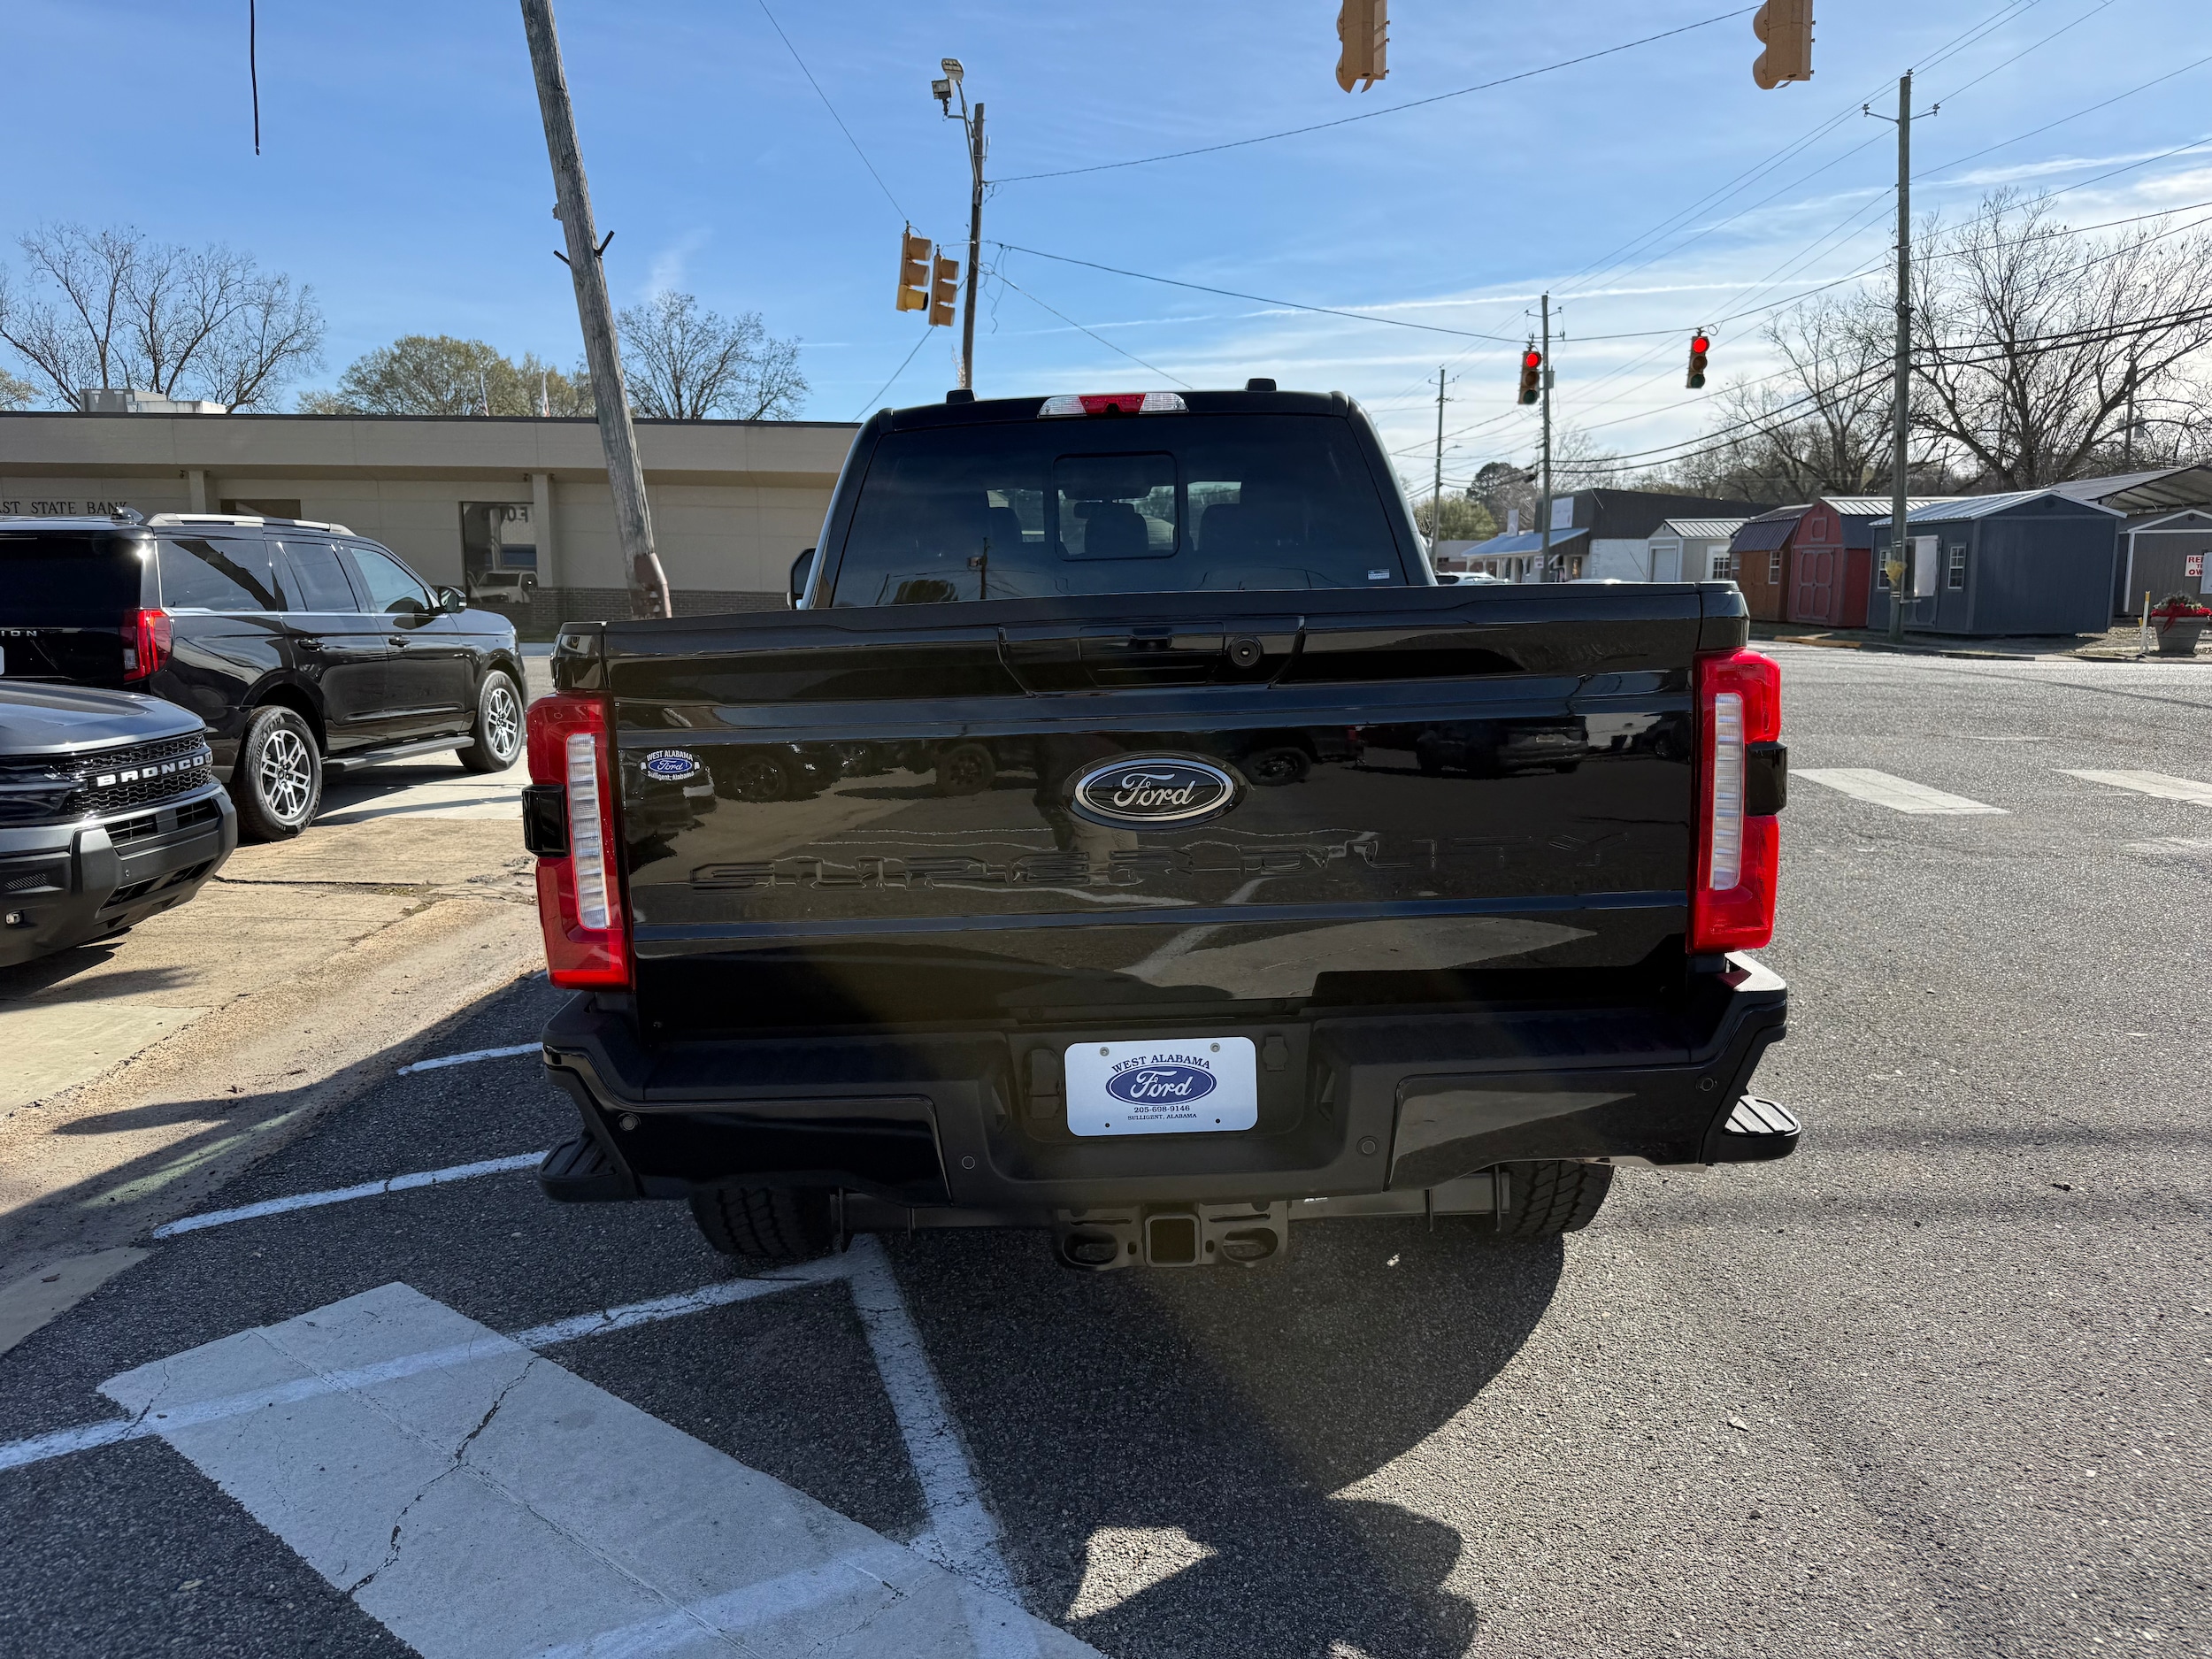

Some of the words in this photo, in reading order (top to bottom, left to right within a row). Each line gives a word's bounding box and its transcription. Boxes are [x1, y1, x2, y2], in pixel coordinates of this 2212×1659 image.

[0, 501, 20, 514] ST
[31, 501, 77, 514] STATE
[647, 750, 664, 761] WEST
[664, 750, 693, 761] ALABAMA
[657, 760, 684, 770] Ford
[96, 756, 204, 787] BRONCO
[672, 771, 695, 780] Alabama
[1113, 772, 1196, 807] Ford
[689, 849, 1195, 895] SUPER
[1238, 832, 1630, 877] DUTY
[1111, 1056, 1147, 1073] WEST
[1150, 1054, 1210, 1069] ALABAMA
[1130, 1070, 1194, 1098] Ford
